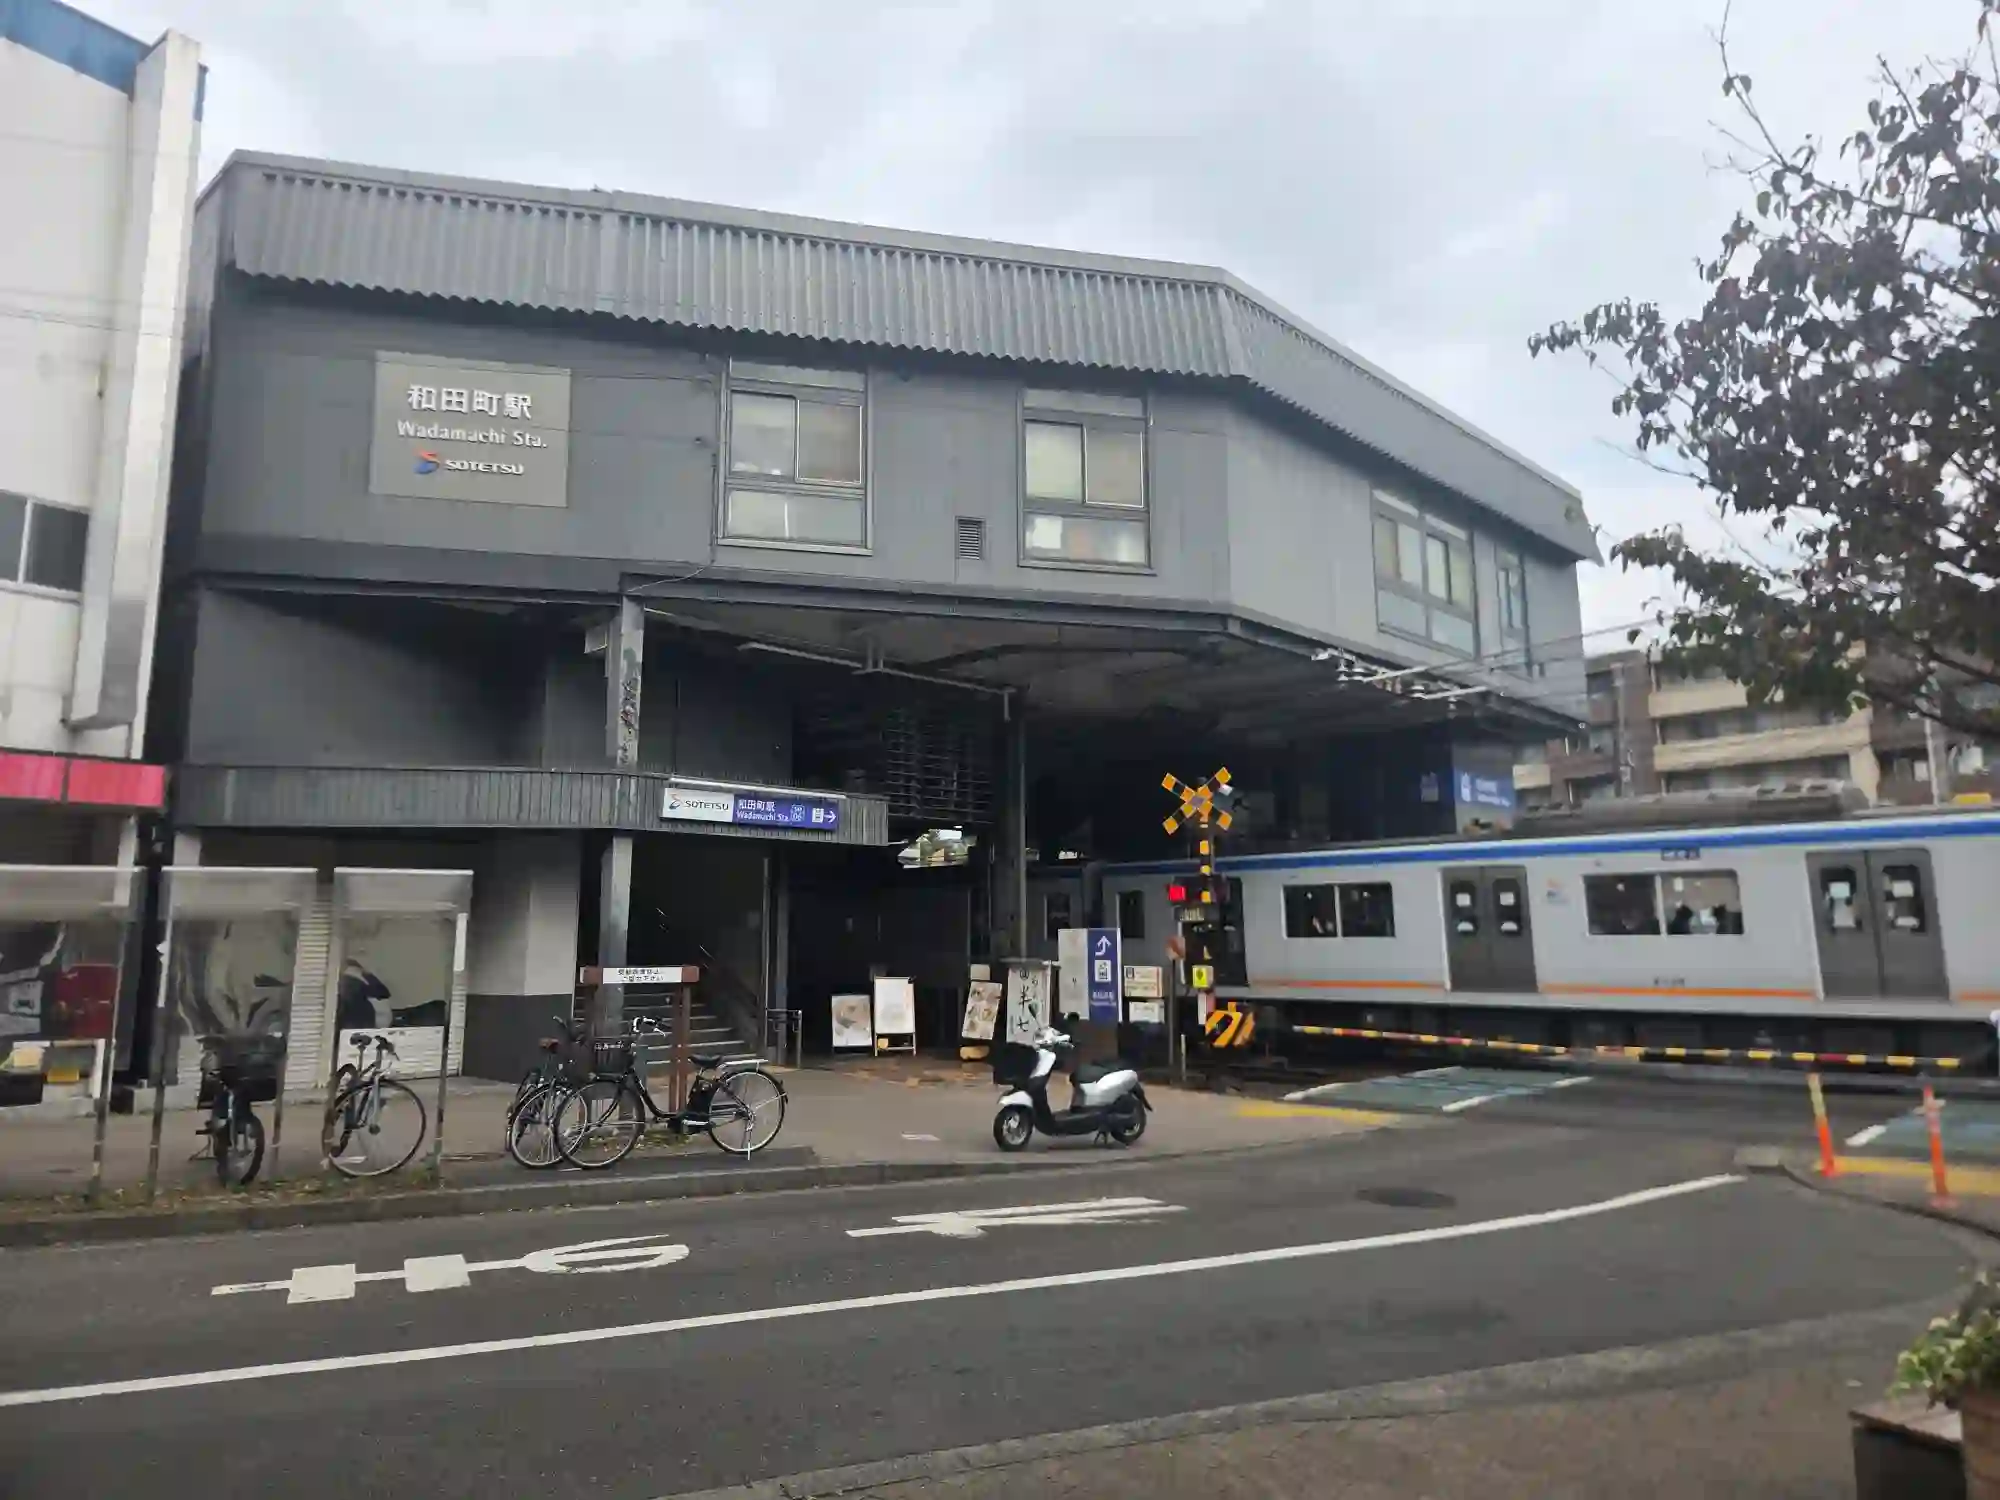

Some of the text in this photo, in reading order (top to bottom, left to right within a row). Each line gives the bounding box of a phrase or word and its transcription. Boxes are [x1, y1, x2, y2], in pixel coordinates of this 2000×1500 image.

[407, 383, 532, 419] 和田町駅
[398, 420, 548, 448] Wadamachi Sta.
[445, 459, 524, 475] SOTETSU
[685, 800, 729, 811] SOTETSU
[739, 799, 776, 813] 和田町駅
